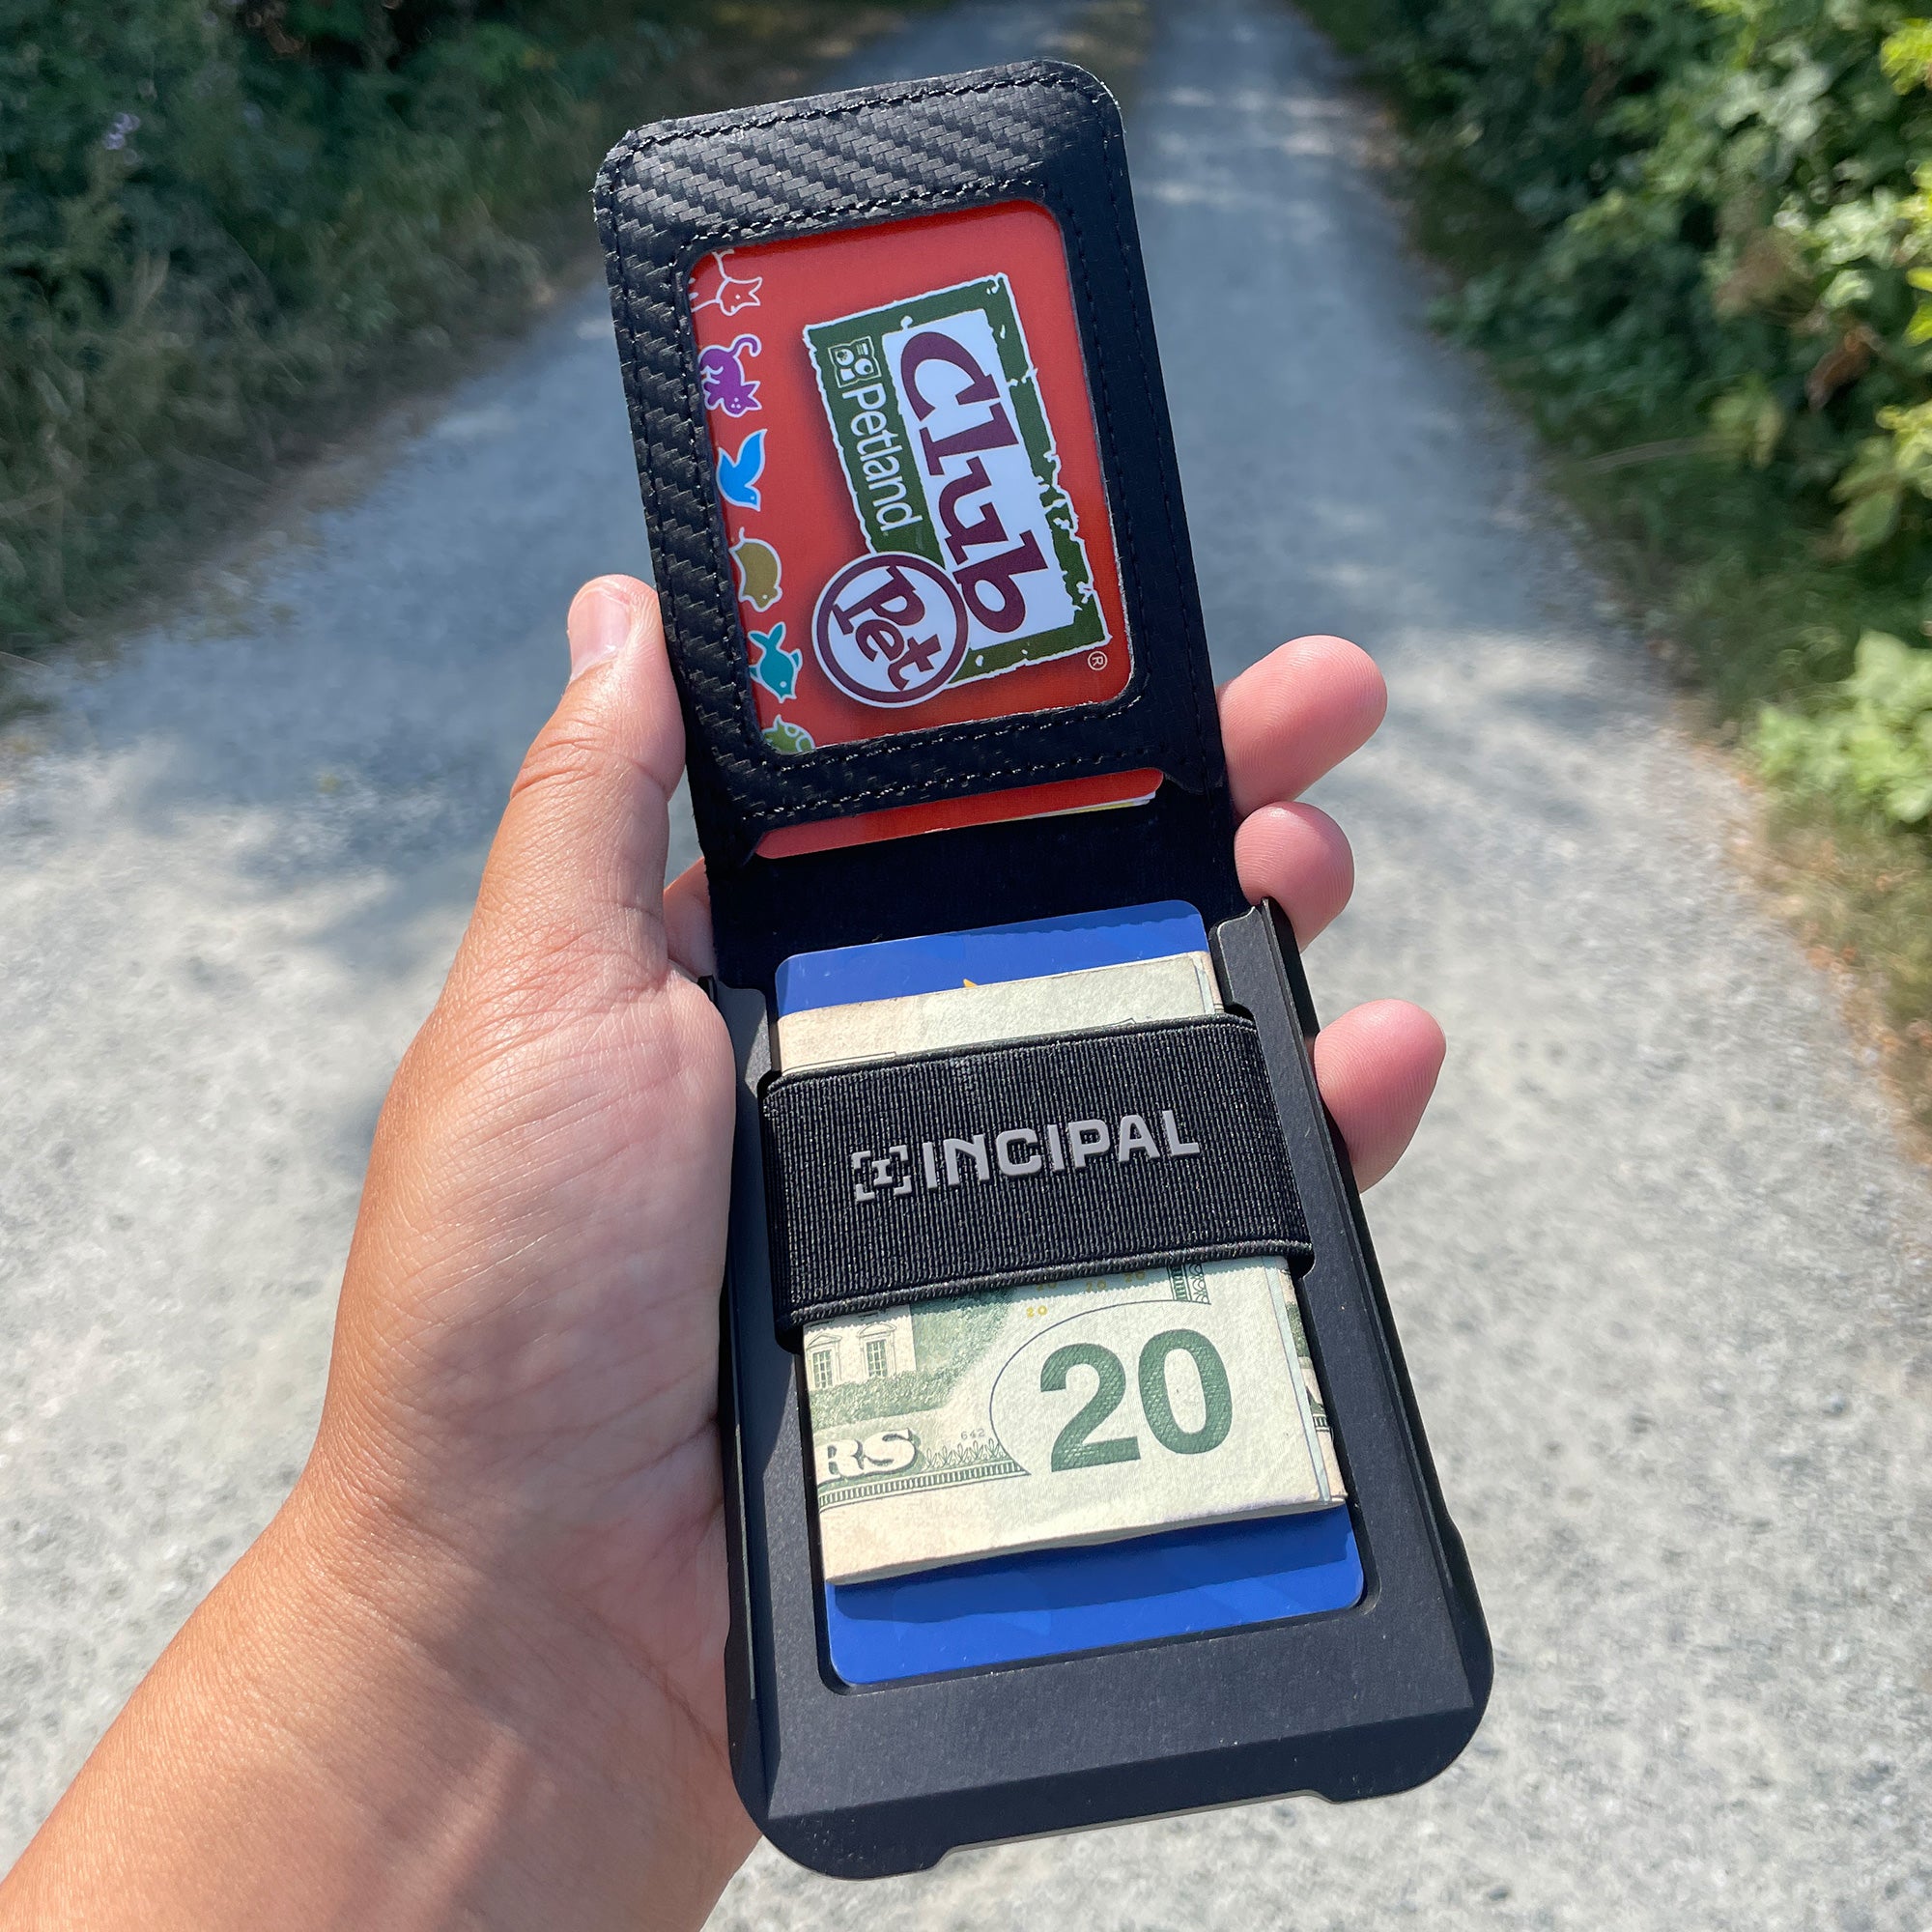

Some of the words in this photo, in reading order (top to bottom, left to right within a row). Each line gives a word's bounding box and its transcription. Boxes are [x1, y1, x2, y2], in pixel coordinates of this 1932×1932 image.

[842, 384, 923, 531] Petland
[901, 331, 1047, 633] Club
[832, 565, 941, 691] Pet
[922, 1110, 1200, 1189] INCIPAL
[1026, 1305, 1048, 1318] 20
[1040, 1328, 1233, 1472] 20
